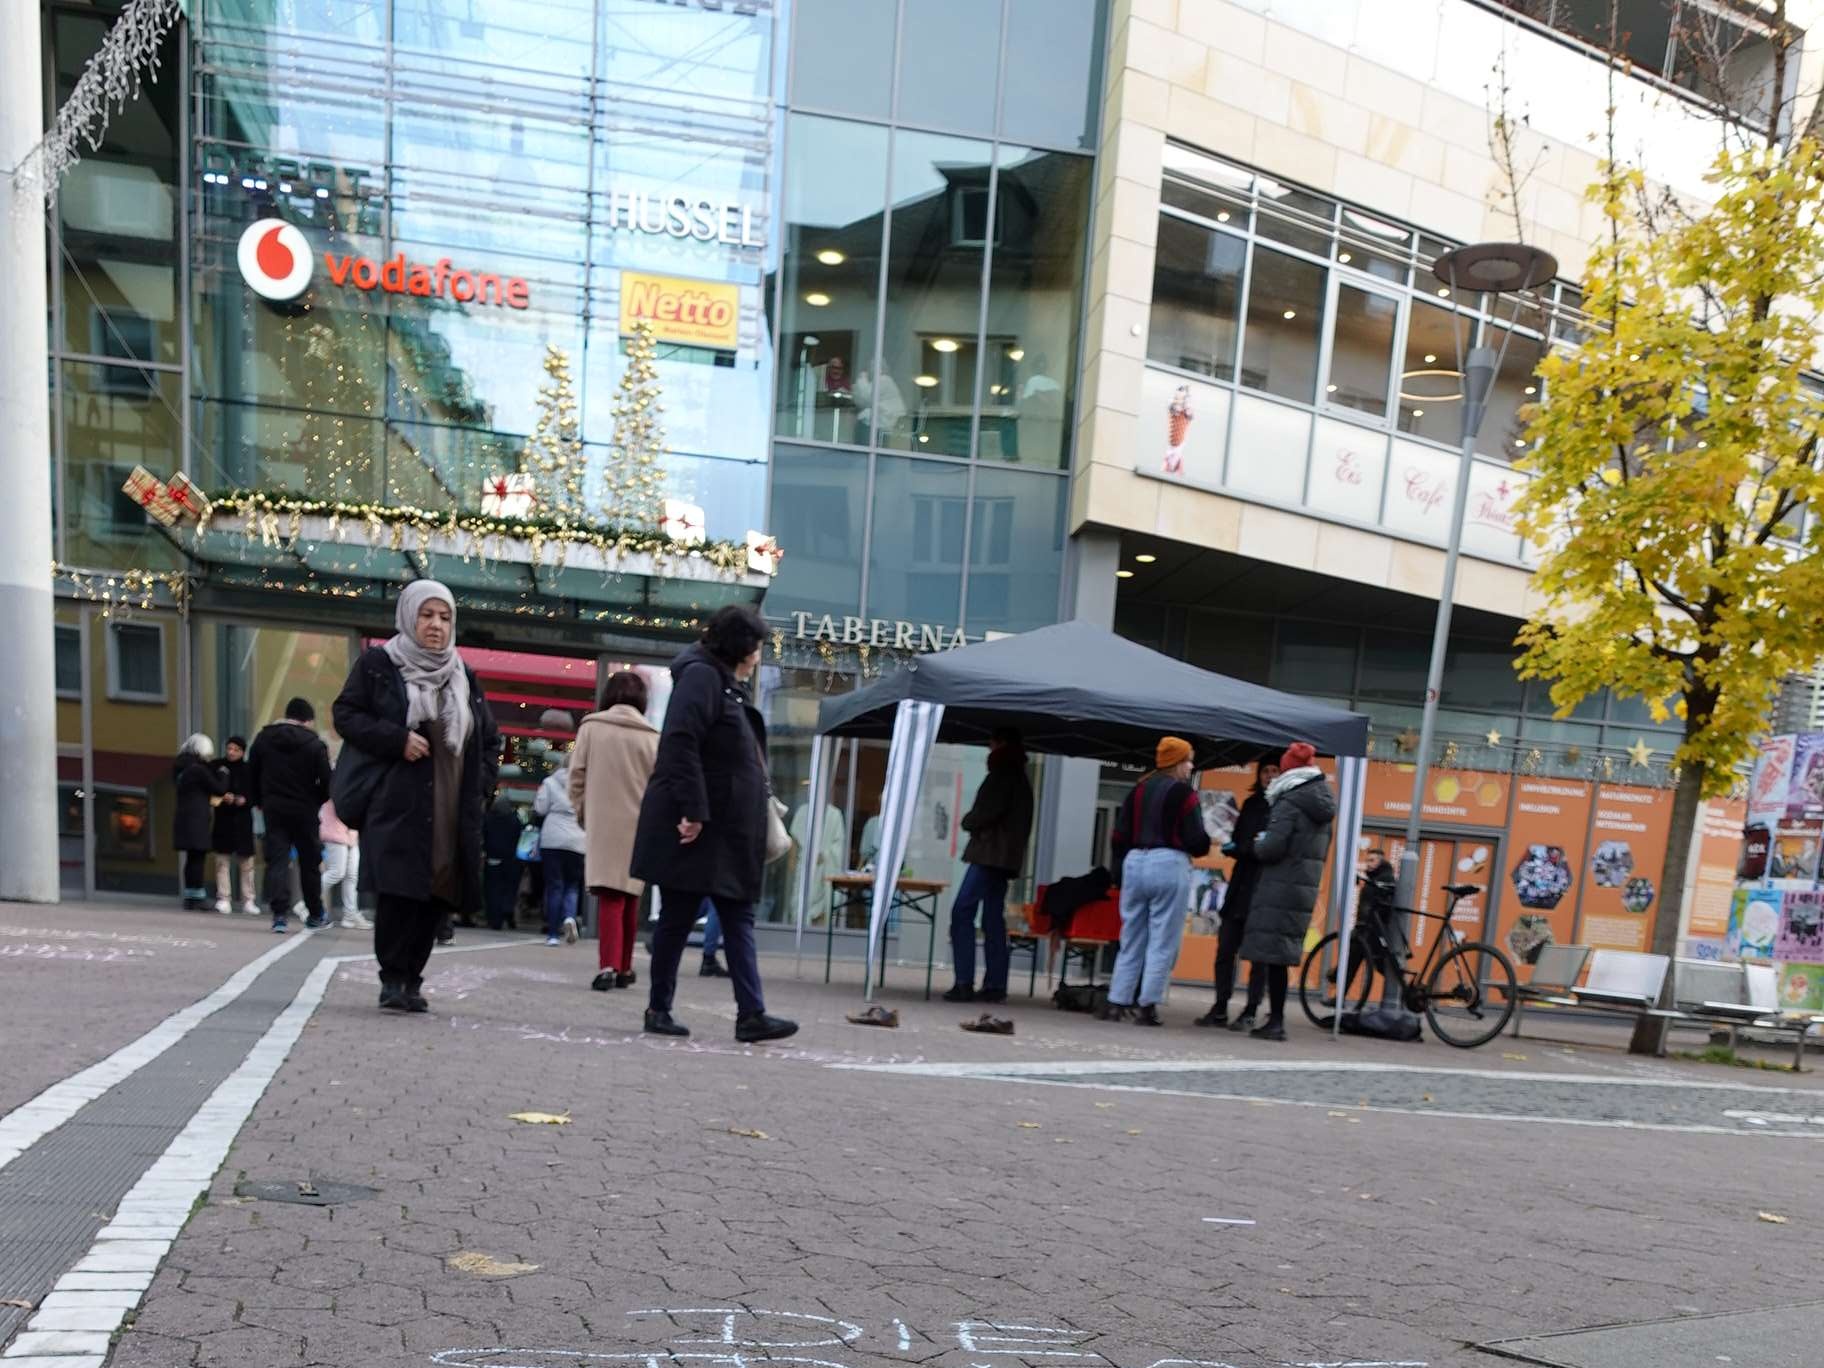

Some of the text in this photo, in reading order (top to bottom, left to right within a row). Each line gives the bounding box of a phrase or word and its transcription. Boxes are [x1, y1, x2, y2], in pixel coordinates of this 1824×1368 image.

[610, 191, 767, 248] HUSSEL
[324, 252, 529, 310] vodafone
[628, 280, 733, 328] Netto
[791, 610, 968, 652] TABERNA
